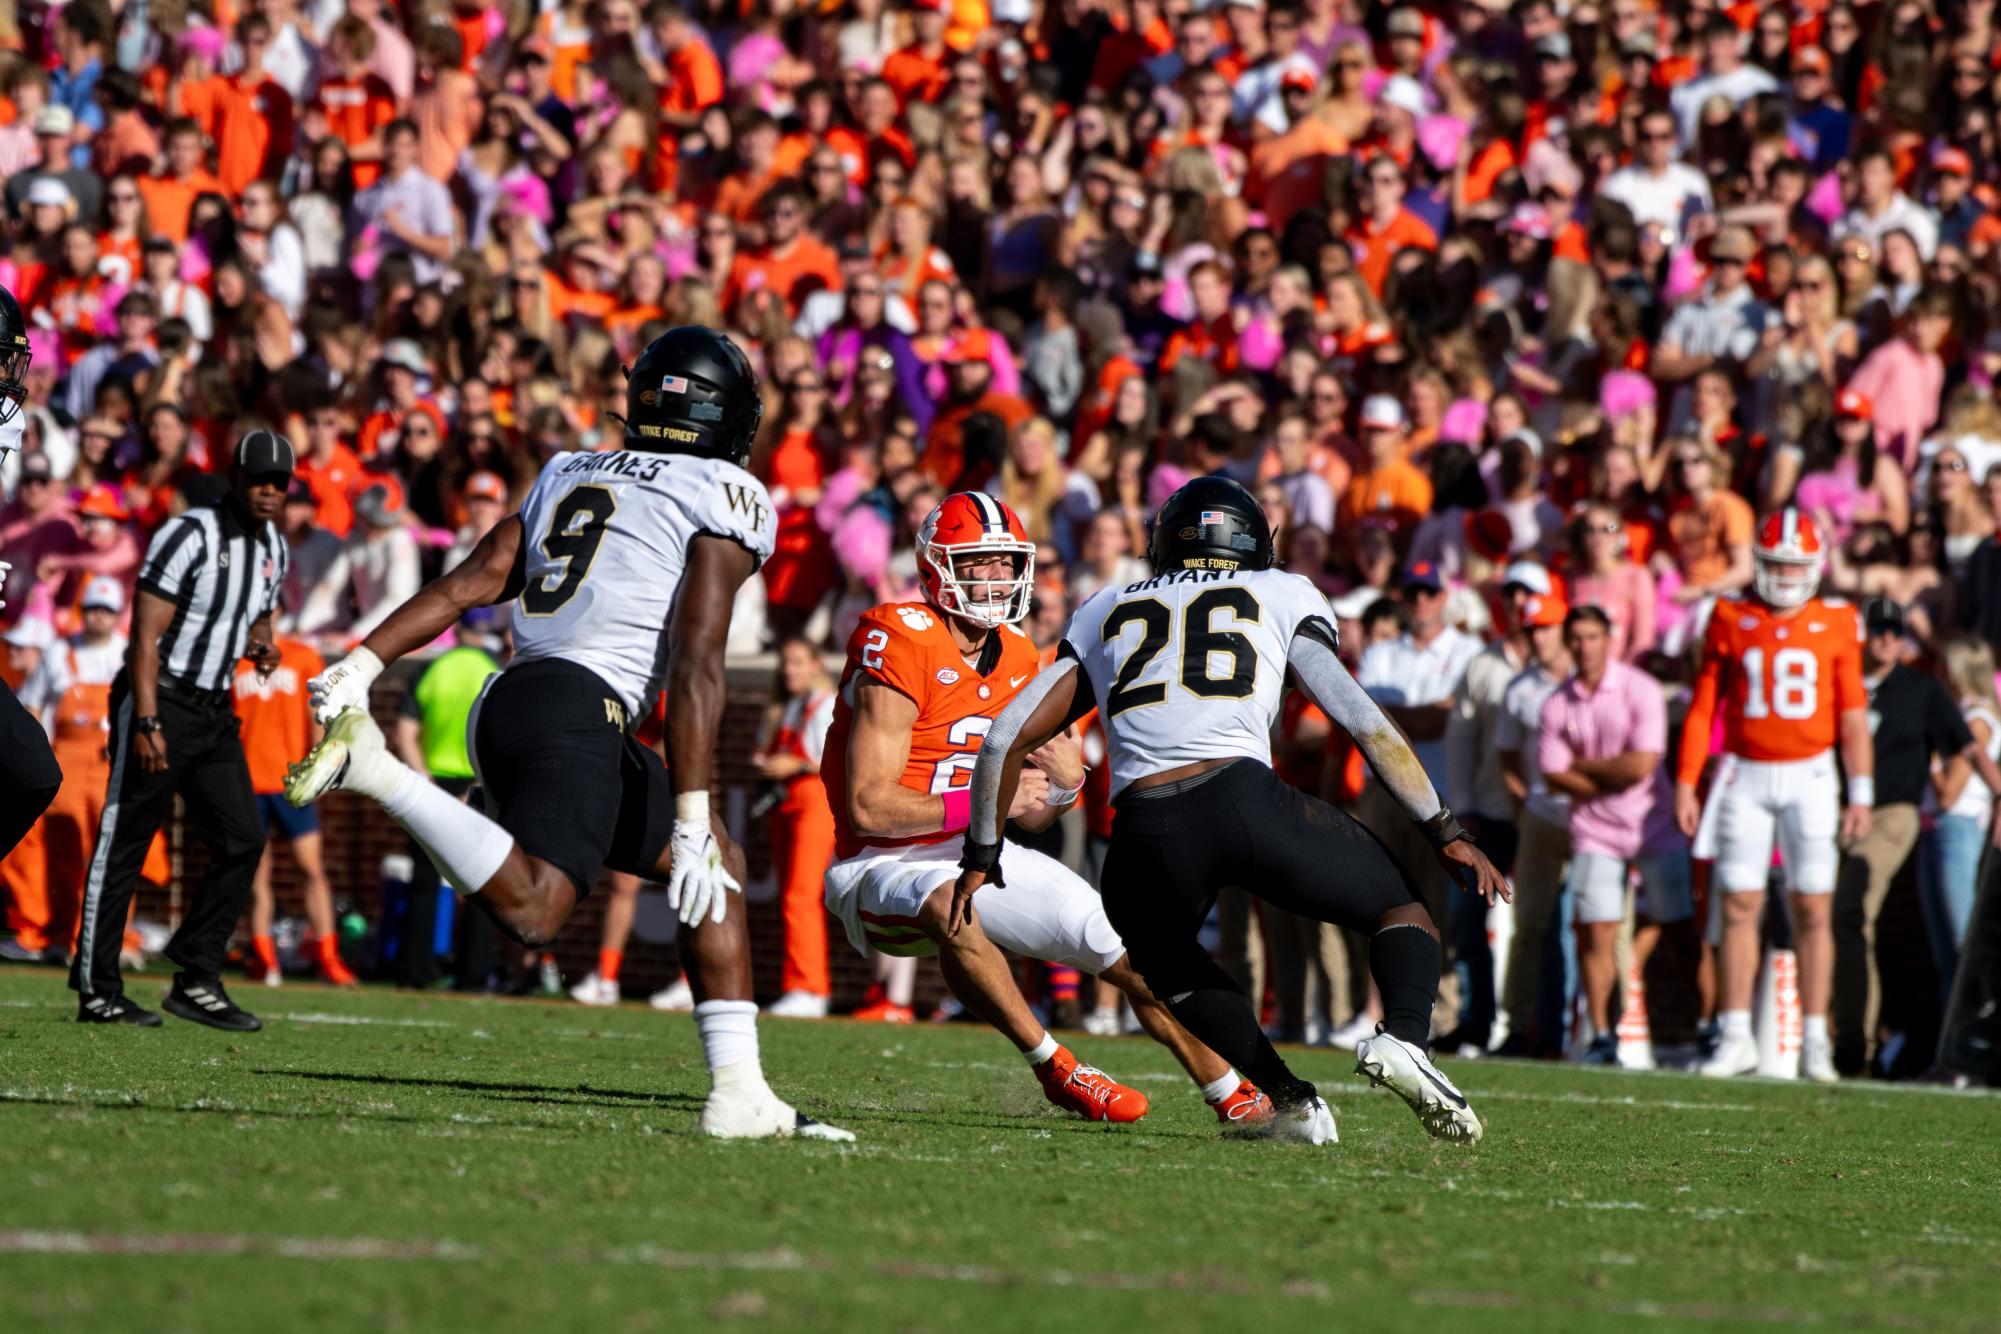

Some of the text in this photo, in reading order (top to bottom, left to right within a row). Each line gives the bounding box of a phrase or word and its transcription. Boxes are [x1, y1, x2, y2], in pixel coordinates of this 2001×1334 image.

[663, 427, 699, 443] FOREST
[720, 481, 768, 532] WF
[219, 552, 229, 568] S
[519, 482, 618, 618] 9
[1183, 558, 1239, 571] WAKE FOREST
[1124, 569, 1237, 594] BRYANT
[861, 628, 889, 670] 2
[1101, 585, 1263, 720] 26
[1742, 647, 1818, 719] 18
[928, 714, 994, 796] 2
